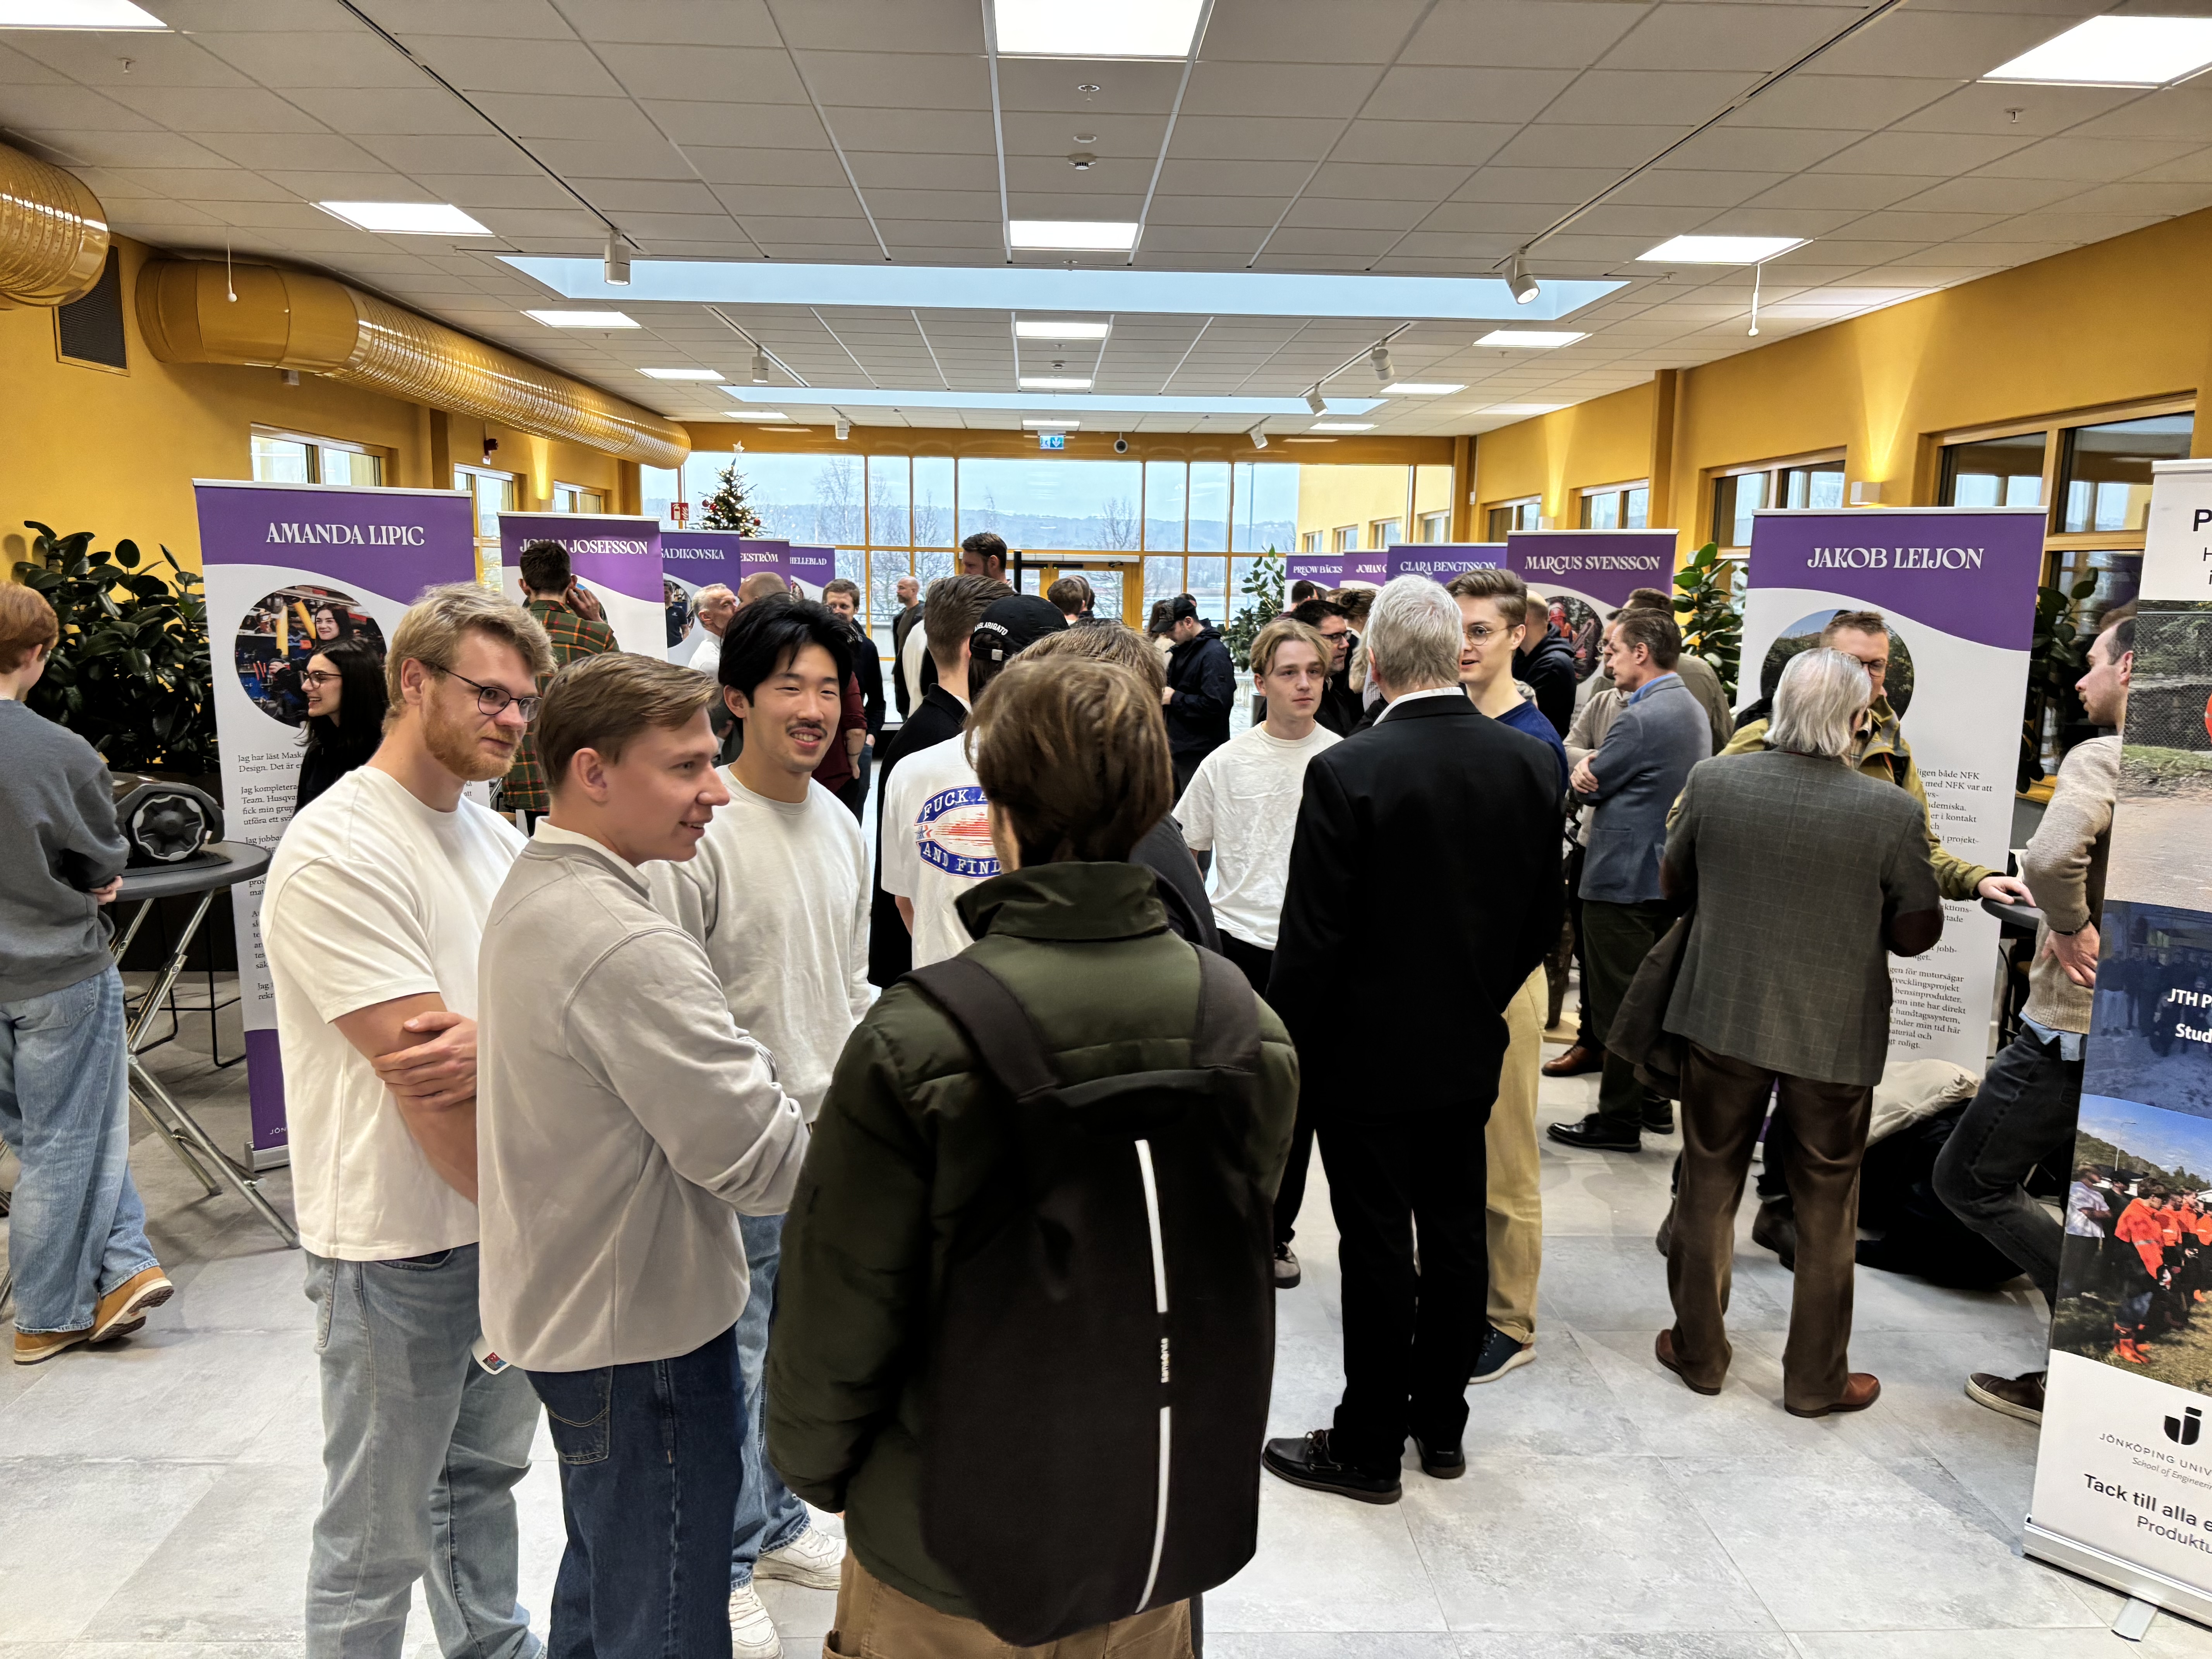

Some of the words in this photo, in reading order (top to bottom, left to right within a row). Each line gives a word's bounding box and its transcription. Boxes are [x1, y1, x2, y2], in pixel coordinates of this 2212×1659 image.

[266, 522, 364, 544] AMANDA
[370, 526, 424, 546] LIPIC
[570, 540, 647, 554] JOSEFSSON
[1400, 561, 1432, 575] CLARA
[1434, 562, 1496, 572] BENGTSSON
[1524, 556, 1582, 575] MARCUS
[1585, 556, 1660, 570] SVENSSON
[1807, 548, 1887, 568] JAKOB
[1894, 548, 1984, 569] LEIJON
[1356, 564, 1381, 573] JOHAN
[984, 622, 1008, 635] ARIGATO
[238, 755, 250, 763] Jag
[1939, 769, 1958, 778] både
[1960, 771, 1980, 780] NFK
[1946, 781, 1965, 790] NFK
[923, 789, 969, 821] FUCK
[1946, 813, 1976, 823] kontakt
[923, 842, 949, 867] AND
[955, 858, 1001, 874] FIND
[2167, 988, 2198, 1006] JTH
[2201, 994, 2212, 1008] P
[1942, 1004, 1966, 1014] direkt
[2175, 1023, 2212, 1043] Stud
[2099, 1433, 2175, 1464] JÖNKÖPING
[2180, 1459, 2212, 1476] UNIV
[2132, 1457, 2159, 1472] School
[2161, 1468, 2171, 1477] of
[2084, 1474, 2128, 1502] Tack
[2133, 1492, 2157, 1512] till
[2162, 1505, 2197, 1527] alla
